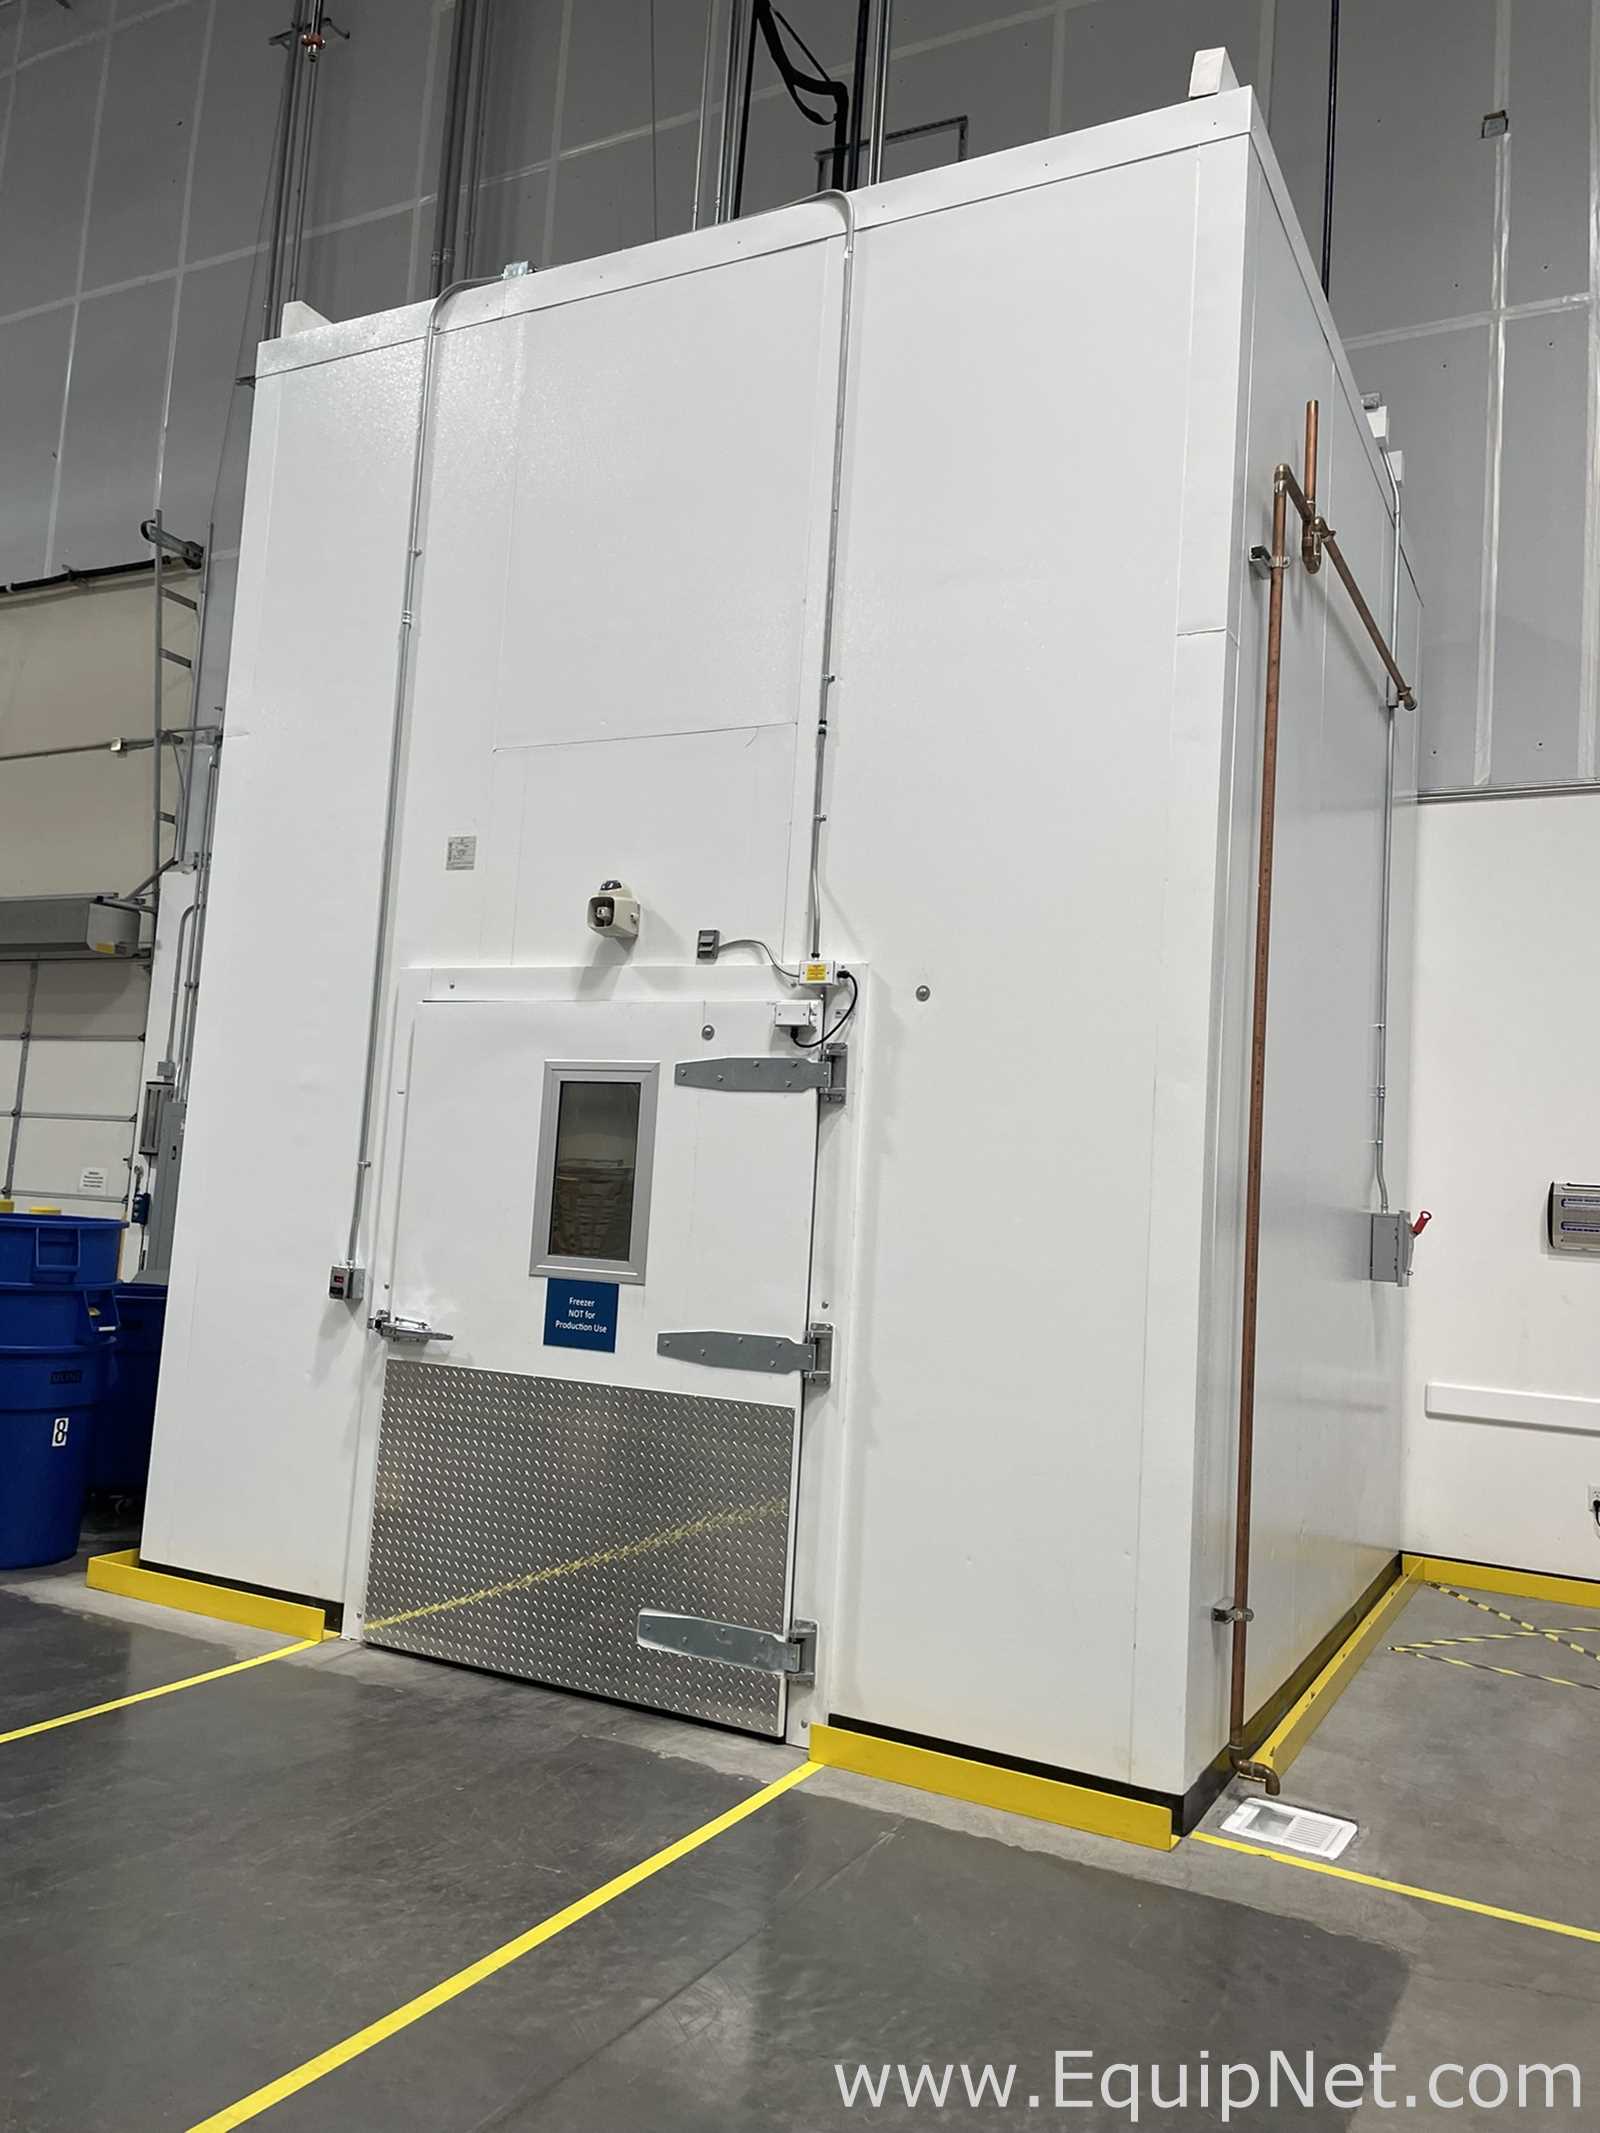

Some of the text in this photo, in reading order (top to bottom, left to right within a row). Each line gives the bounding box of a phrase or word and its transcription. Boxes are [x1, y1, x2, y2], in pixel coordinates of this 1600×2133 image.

[568, 1296, 596, 1307] Freezer
[567, 1309, 597, 1320] NOT for
[555, 1319, 608, 1334] Production Use
[54, 1419, 67, 1444] 8
